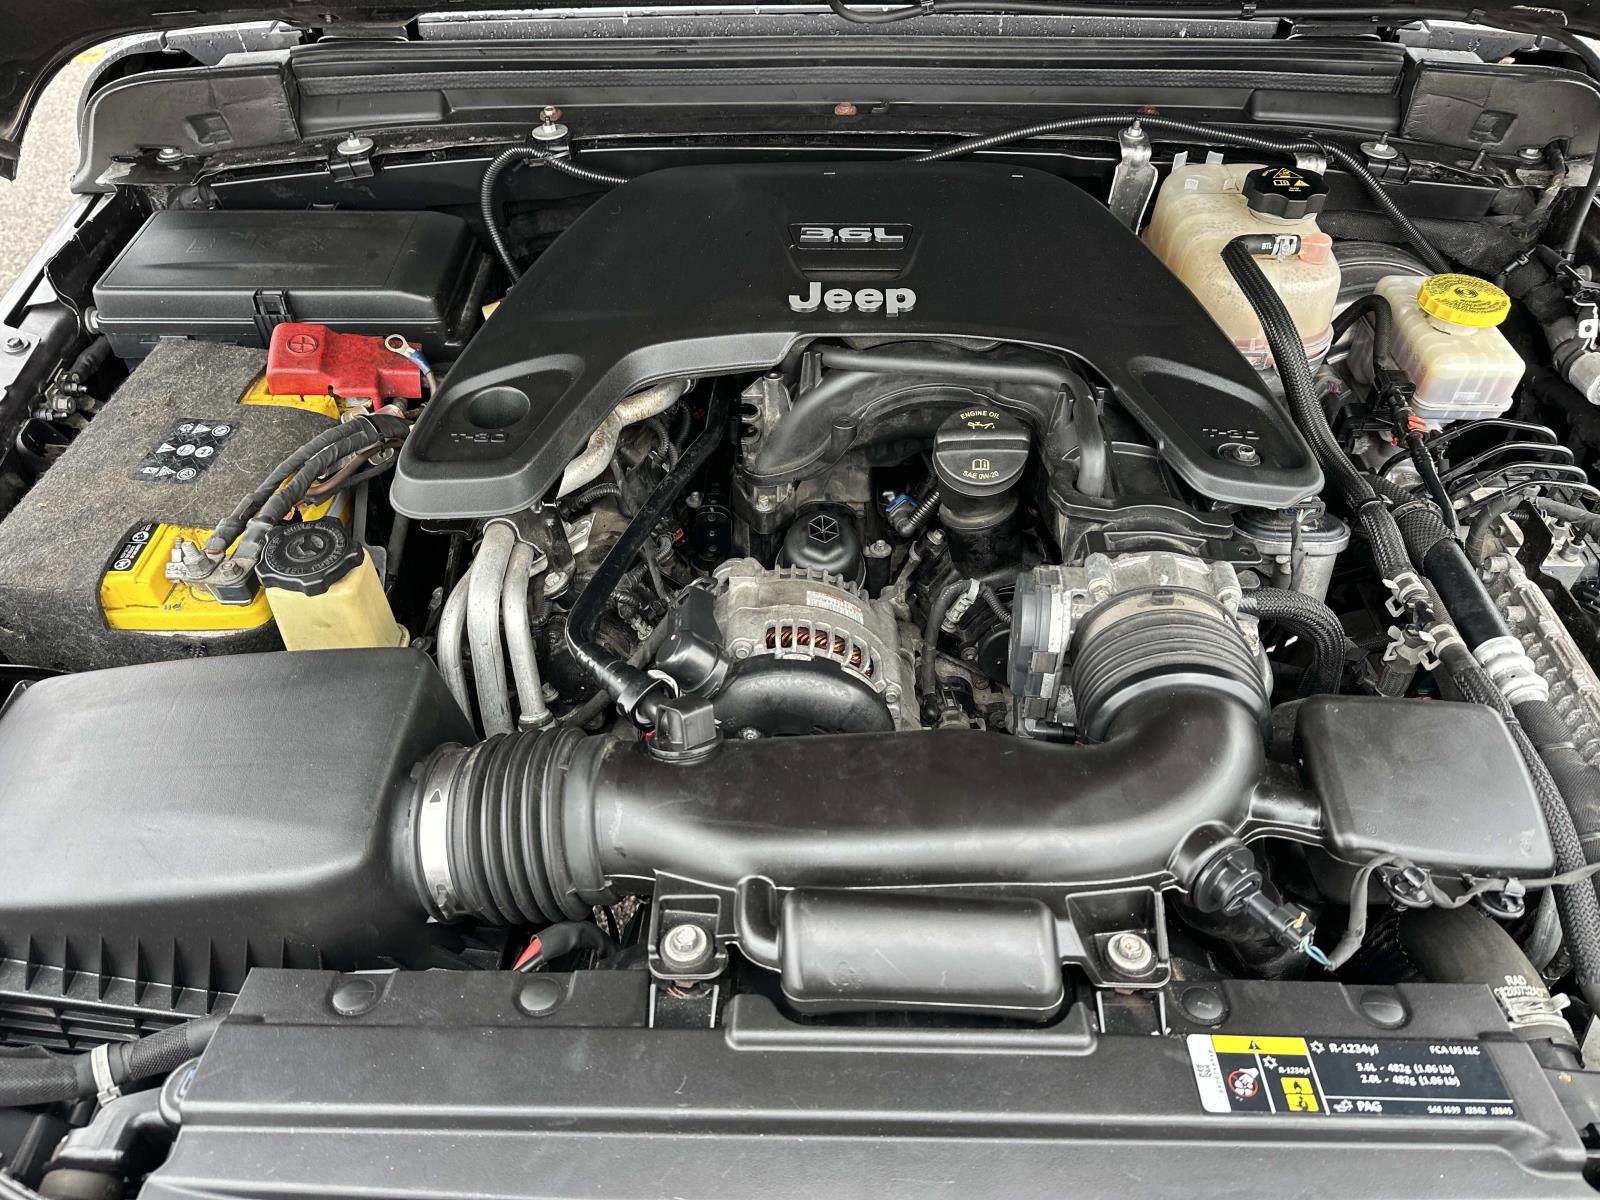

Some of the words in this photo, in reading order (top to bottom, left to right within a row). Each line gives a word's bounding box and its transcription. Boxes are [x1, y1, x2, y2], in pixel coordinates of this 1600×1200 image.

[800, 228, 904, 242] 3.6L
[789, 282, 917, 317] Jeep
[960, 410, 988, 420] ENGINE
[989, 411, 1001, 420] OIL
[962, 470, 977, 479] SAE
[978, 470, 1000, 480] 0W-20
[1504, 975, 1527, 986] RAD
[1329, 1043, 1379, 1057] R-1234yf
[1429, 1045, 1449, 1055] FCA
[1449, 1045, 1463, 1055] US
[1463, 1046, 1480, 1056] LLC
[1355, 1062, 1377, 1072] 3.6L
[1357, 1101, 1383, 1113] PAG
